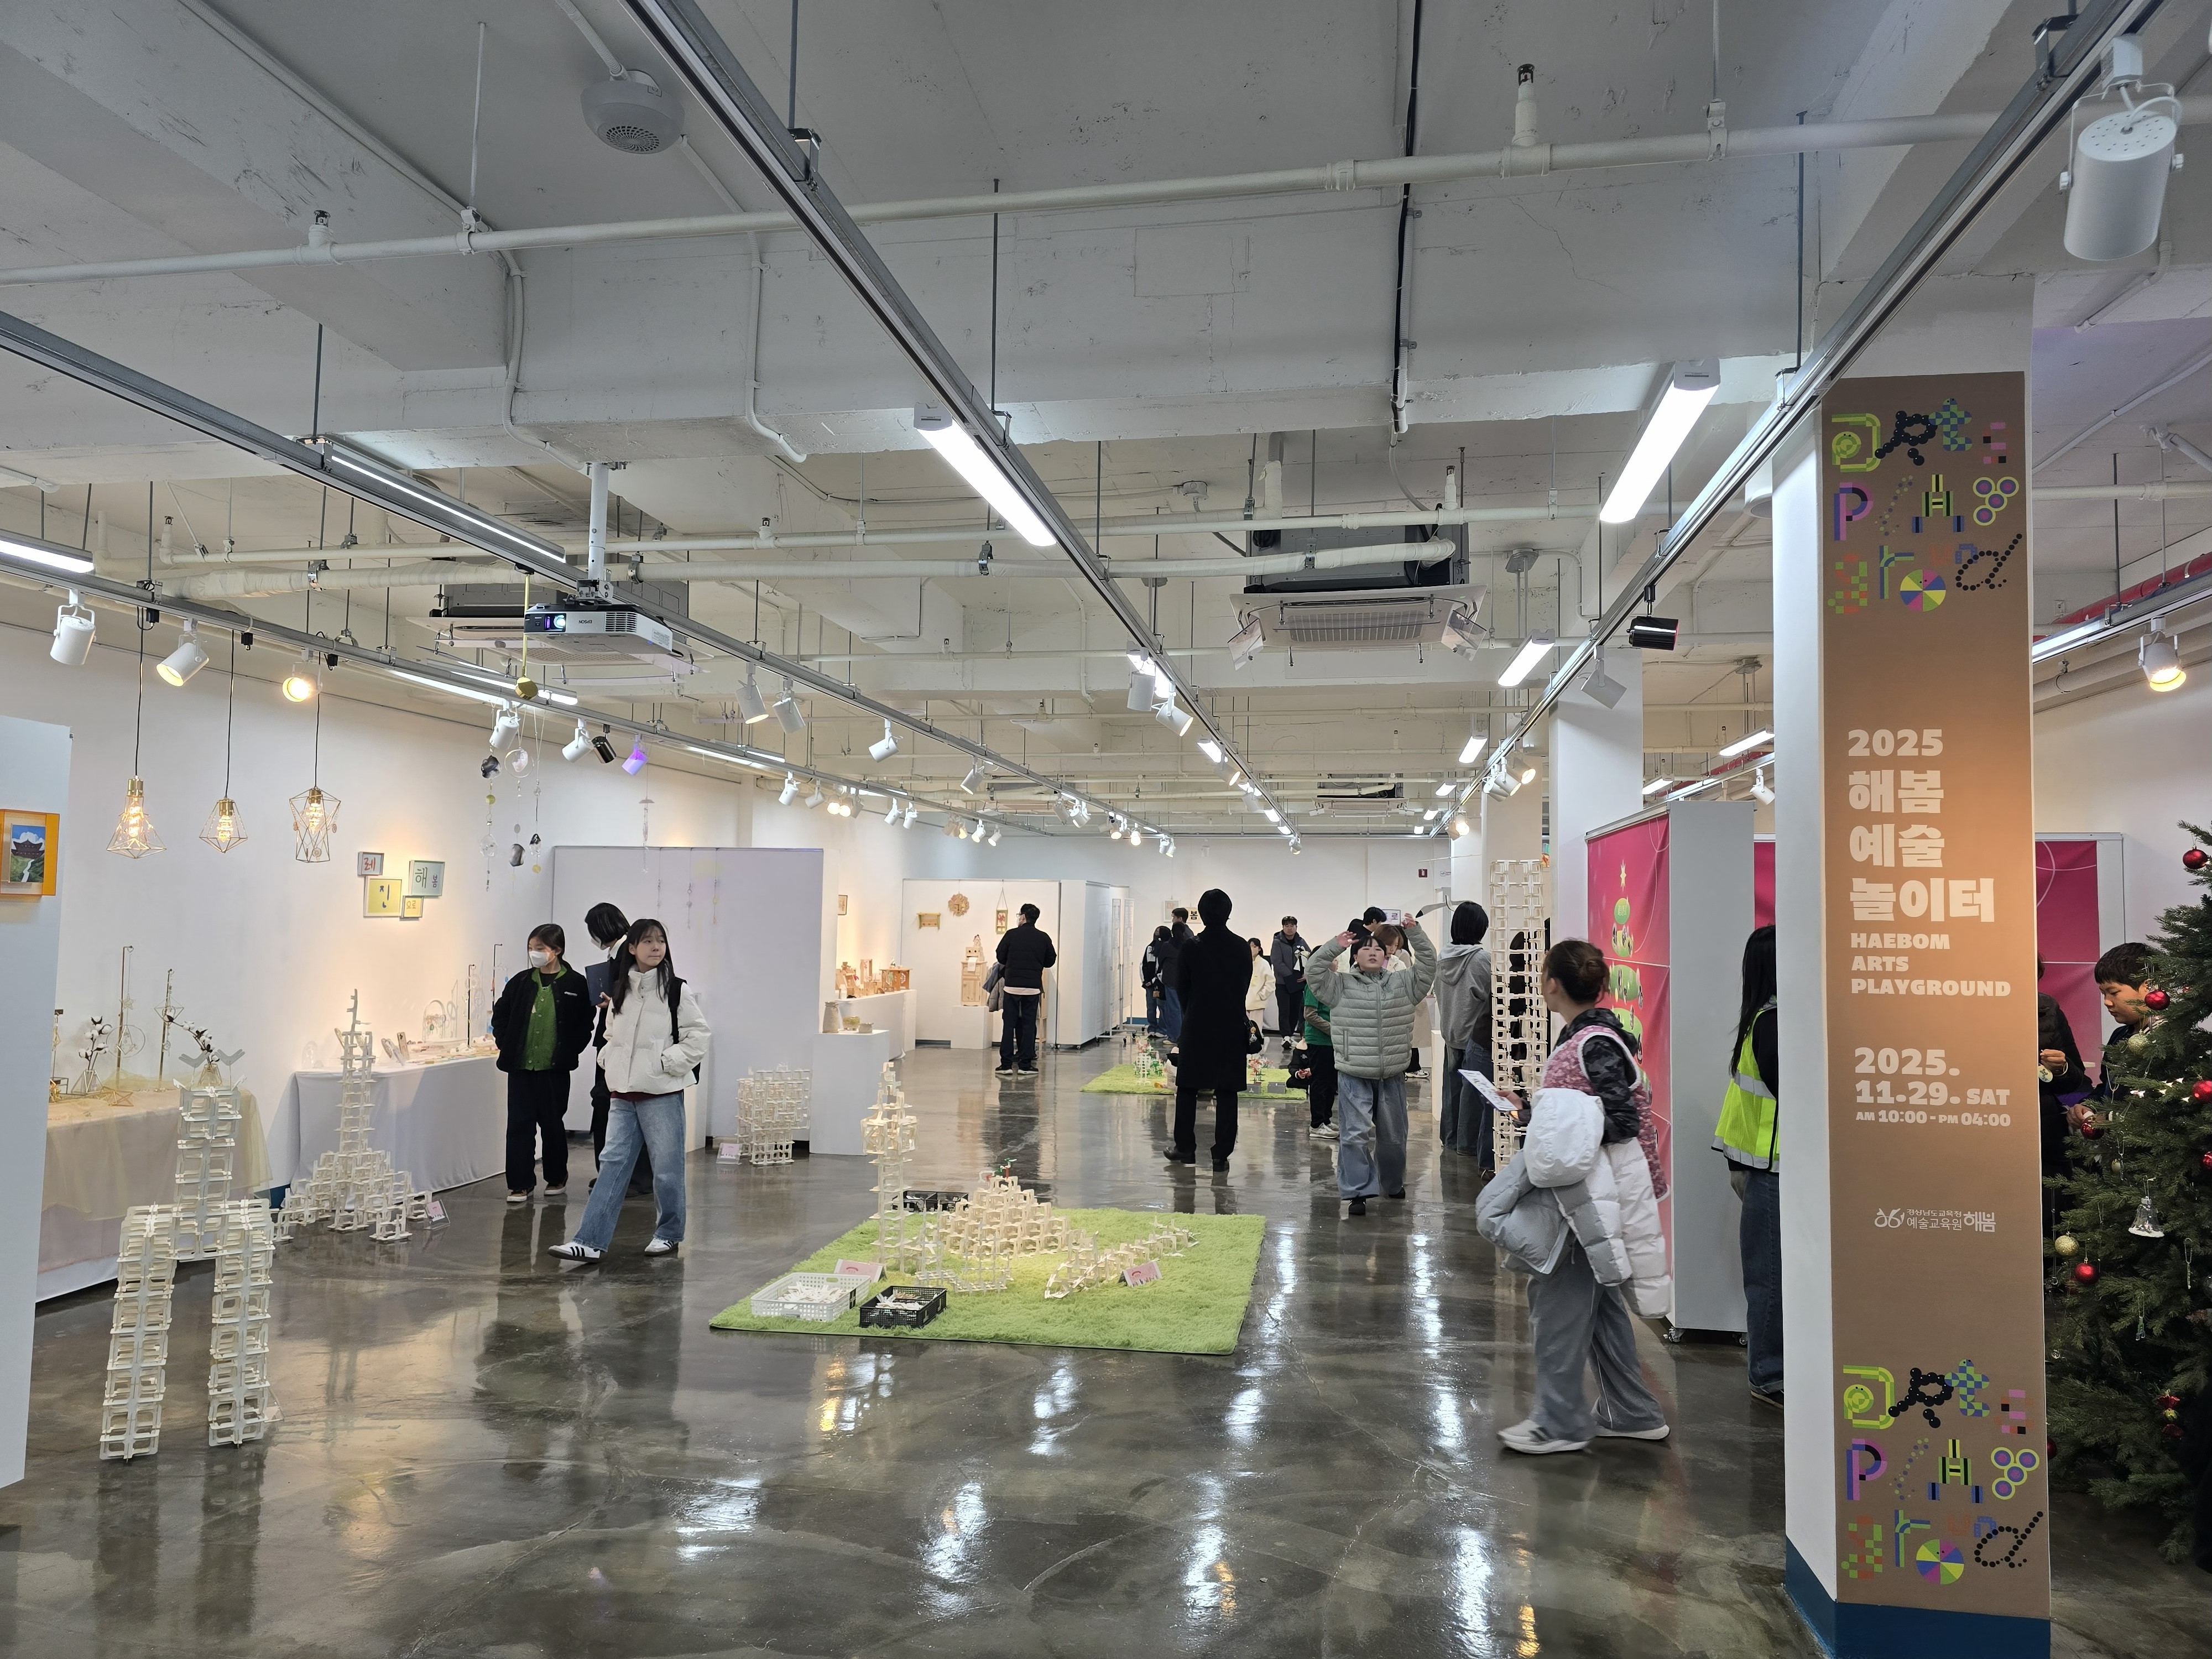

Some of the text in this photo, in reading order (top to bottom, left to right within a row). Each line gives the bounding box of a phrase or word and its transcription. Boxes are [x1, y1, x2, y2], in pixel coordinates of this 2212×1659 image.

[1848, 729, 1943, 757] 2025
[1849, 769, 1944, 813] 해봄
[1849, 823, 1945, 868] 예술
[363, 857, 376, 872] 레
[1850, 878, 1995, 922] 놀이터
[1190, 911, 1198, 920] 봄
[1851, 933, 1950, 950] HAEBOM
[1851, 956, 1909, 972] ARTS
[1851, 978, 2011, 997] PLAYGROUND
[1855, 1047, 1960, 1076] 2025.
[1855, 1079, 2010, 1106] 11.29. SAT
[1855, 1112, 1875, 1121] AM
[1878, 1110, 1927, 1124] 10:00
[1938, 1114, 1959, 1124] PM
[1961, 1113, 2011, 1126] 04:00
[1907, 1217, 1962, 1231] 예술교육원
